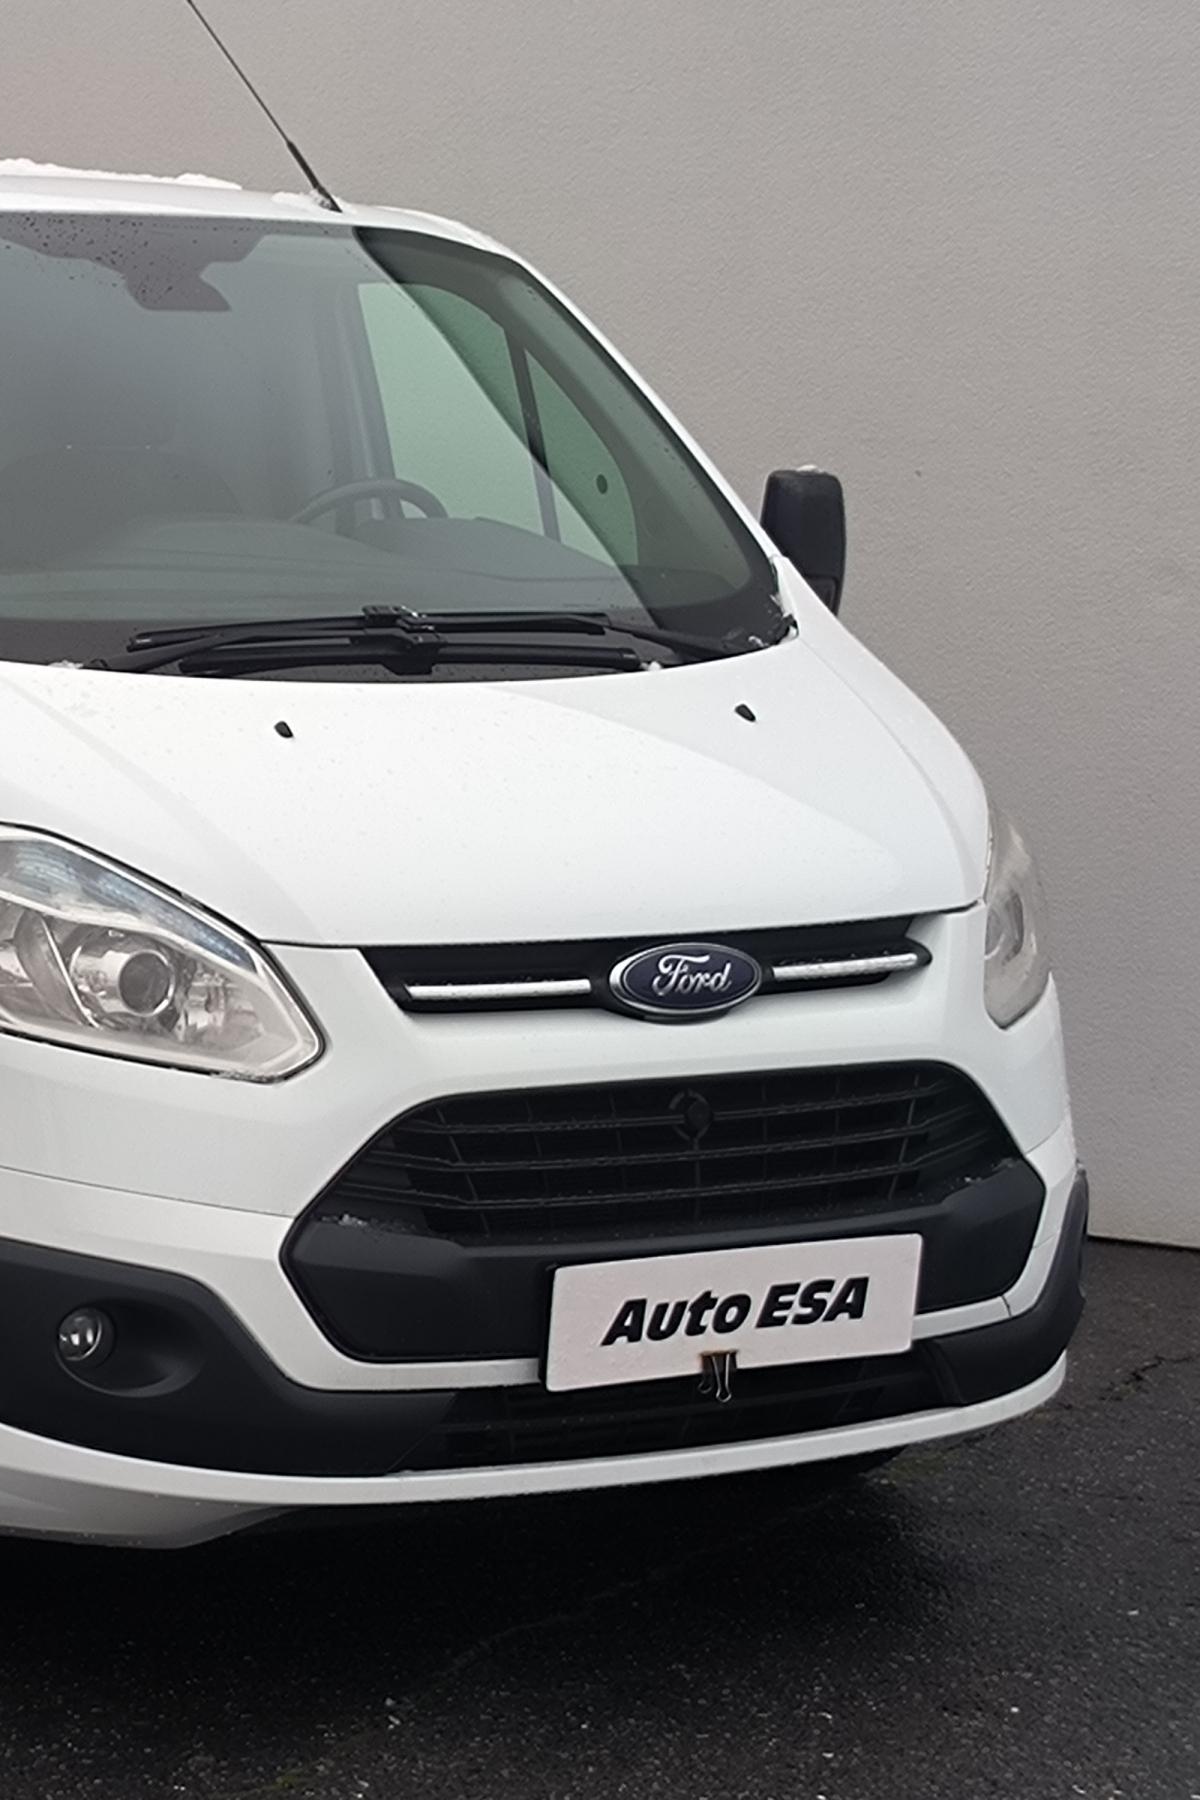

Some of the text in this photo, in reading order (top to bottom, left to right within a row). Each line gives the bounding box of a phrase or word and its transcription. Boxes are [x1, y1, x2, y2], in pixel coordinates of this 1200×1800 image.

[652, 954, 732, 996] Ford
[601, 1276, 870, 1346] Auto ESA
